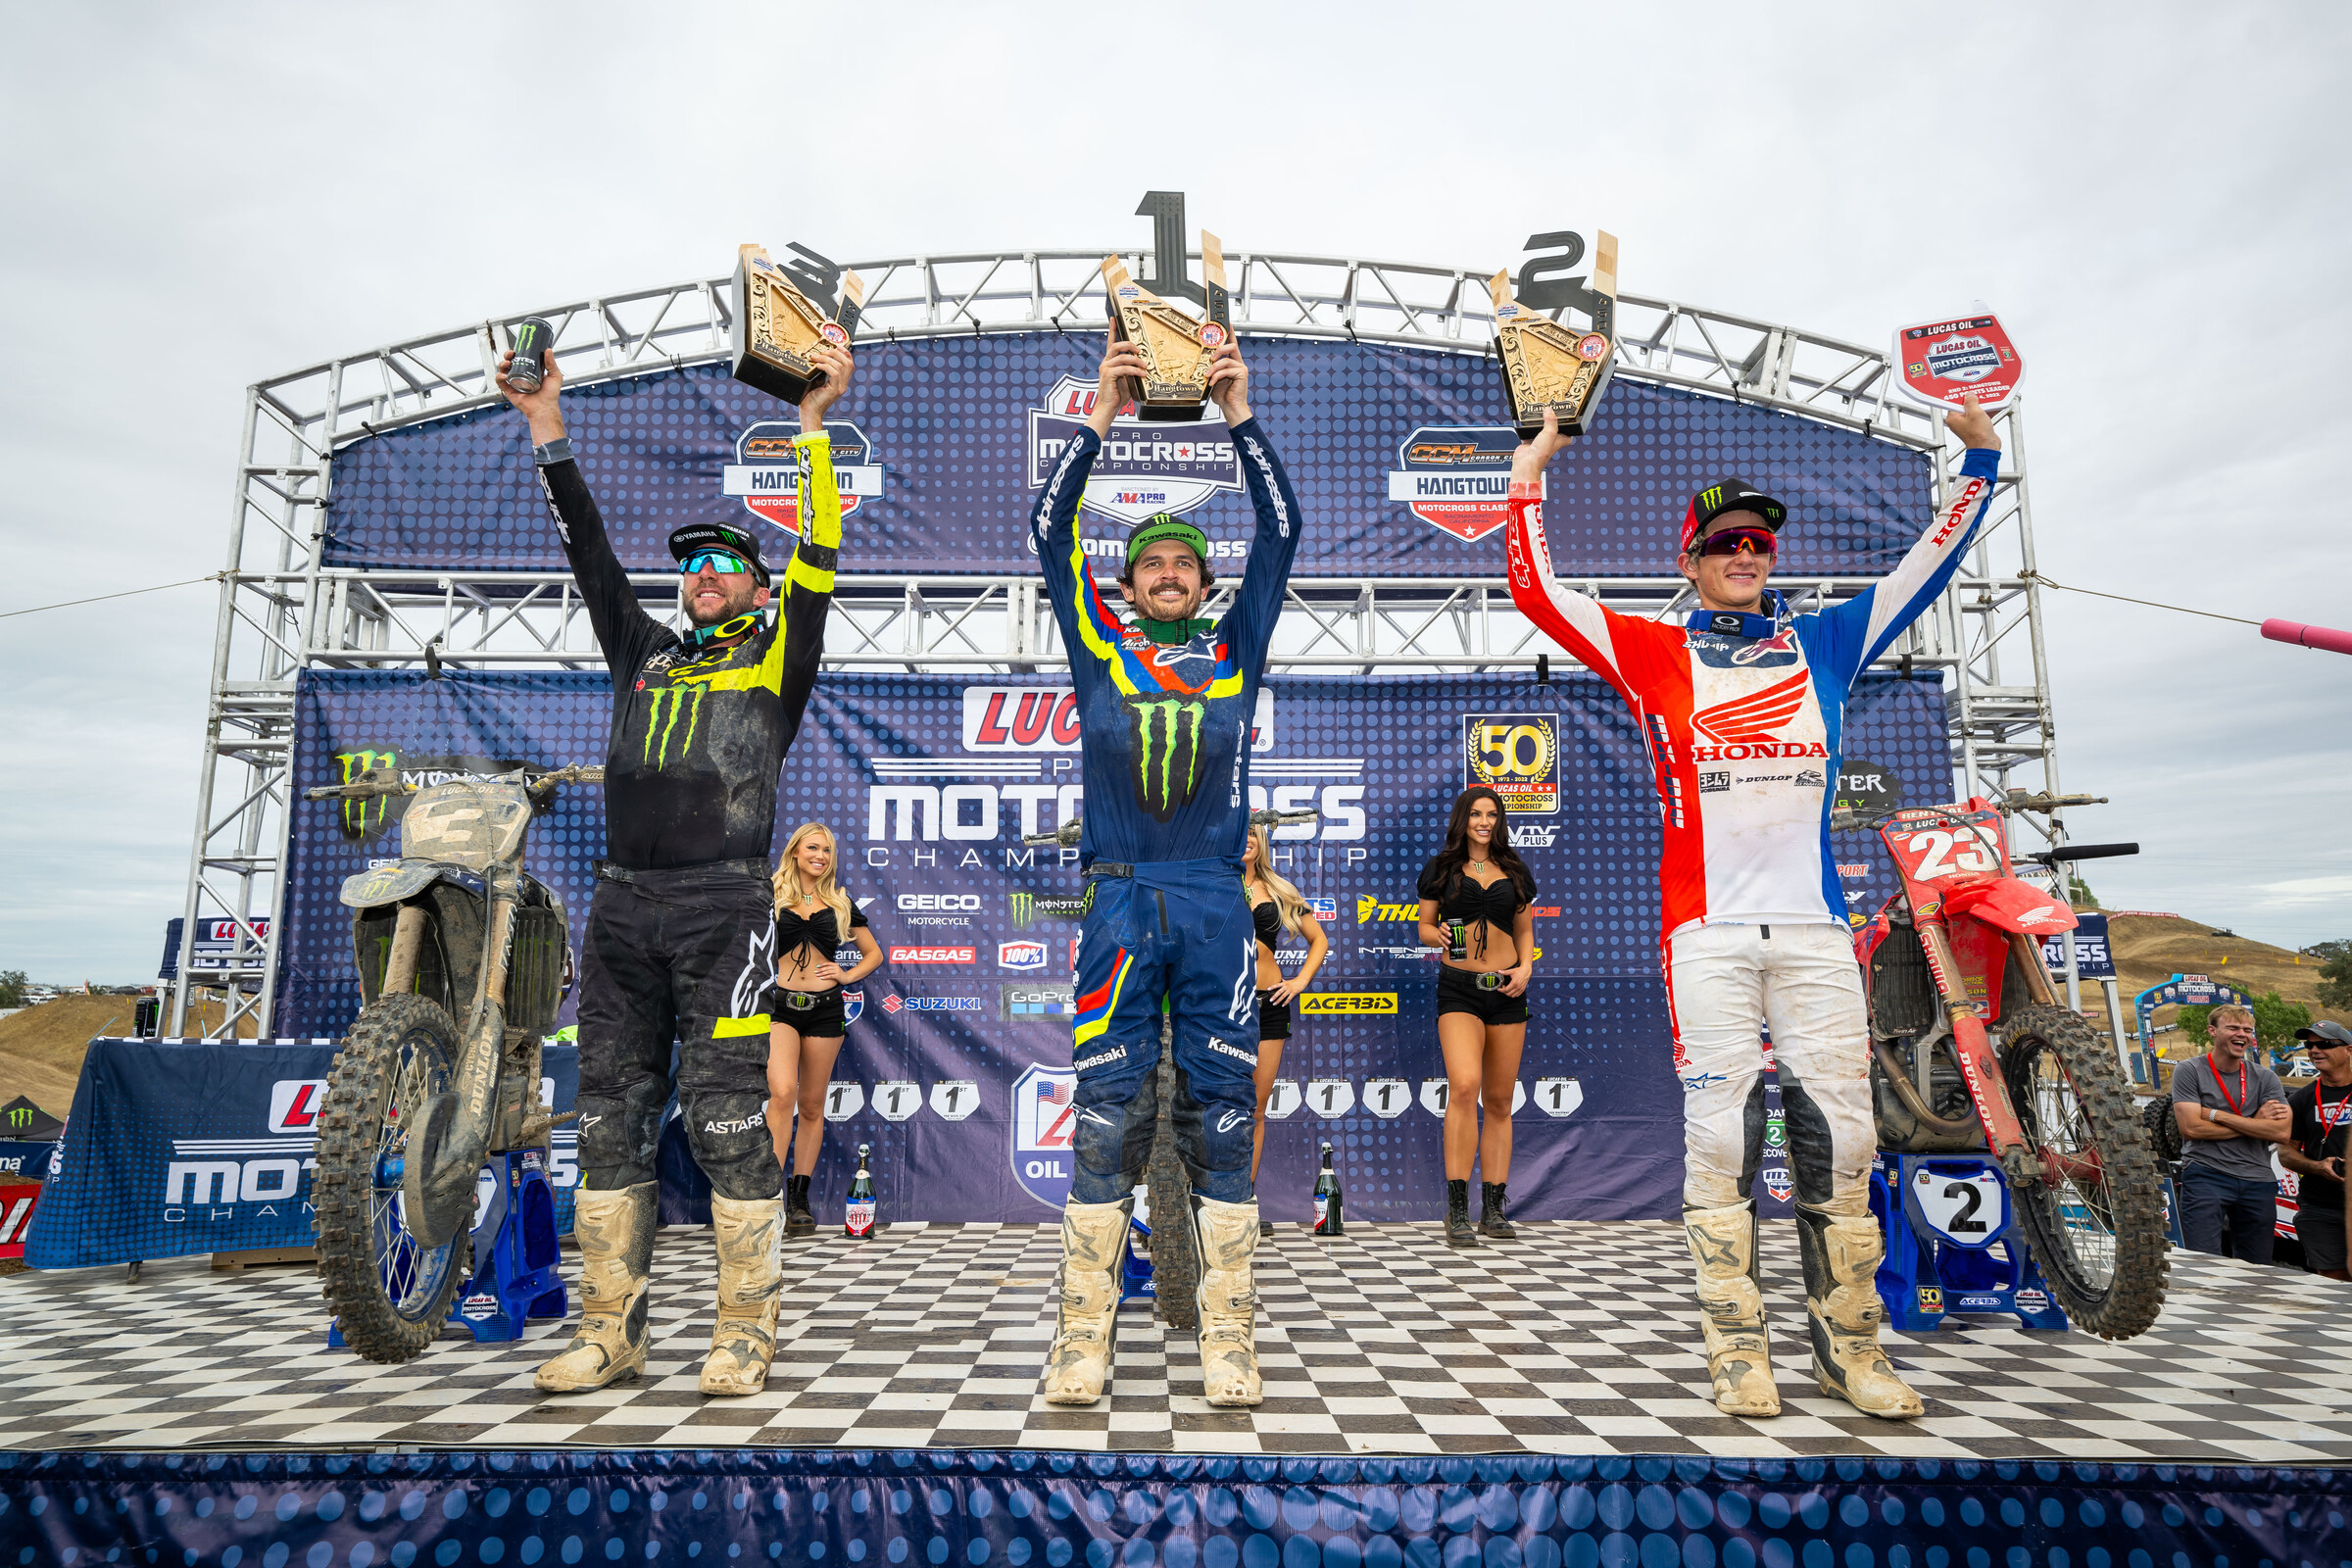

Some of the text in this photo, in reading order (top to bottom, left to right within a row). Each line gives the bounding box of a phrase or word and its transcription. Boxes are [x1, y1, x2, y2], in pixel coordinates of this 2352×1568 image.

[1133, 190, 1206, 308] 1
[778, 241, 841, 297] 3
[1515, 230, 1590, 312] 2
[1928, 320, 1974, 335] LUCAS OIL
[760, 340, 807, 368] Hangtown
[1936, 339, 1982, 354] LUCAS OIL
[1909, 363, 1922, 372] 50
[1932, 353, 1996, 369] MOTOCROSS
[1153, 382, 1198, 393] Hangtown
[1986, 384, 2011, 393] LEADER
[1111, 431, 1162, 440] PRO
[1040, 438, 1235, 462] MTOCROSS
[1409, 444, 1477, 464] CCM
[1040, 460, 1235, 471] CMPIONSHIP
[1109, 492, 1146, 504] AMA
[684, 530, 717, 540] YAMAHA
[1139, 532, 1199, 544] Kawasaki
[1121, 637, 1151, 648] Airoh
[975, 692, 1081, 747] LUC
[1479, 724, 1548, 777] 50
[1692, 742, 1830, 763] HONDA
[1524, 836, 1547, 845] PLUS
[867, 847, 1367, 867] CHAMPHIP
[1909, 825, 2002, 882] 23
[897, 894, 980, 910] GEICO
[1376, 904, 1420, 921] THO
[907, 916, 970, 926] MOTORCYCLE
[2021, 917, 2069, 928] HONDA
[892, 949, 973, 961] GASGAS
[1004, 948, 1041, 962] 100%
[1274, 950, 1334, 959] UNLP
[1919, 932, 1951, 997] SHOWA
[905, 997, 982, 1011] SUZUKI
[1303, 997, 1395, 1010] ACERBIS
[2186, 995, 2209, 1004] FINISH
[470, 1025, 494, 1117] DUNLOP
[1959, 1051, 1996, 1133] DUNLOP
[704, 1111, 763, 1135] ASTARS
[1769, 1127, 1782, 1143] 2
[1025, 1160, 1068, 1179] OIL
[1943, 1182, 1987, 1233] 2
[1921, 1288, 1939, 1304] 50
